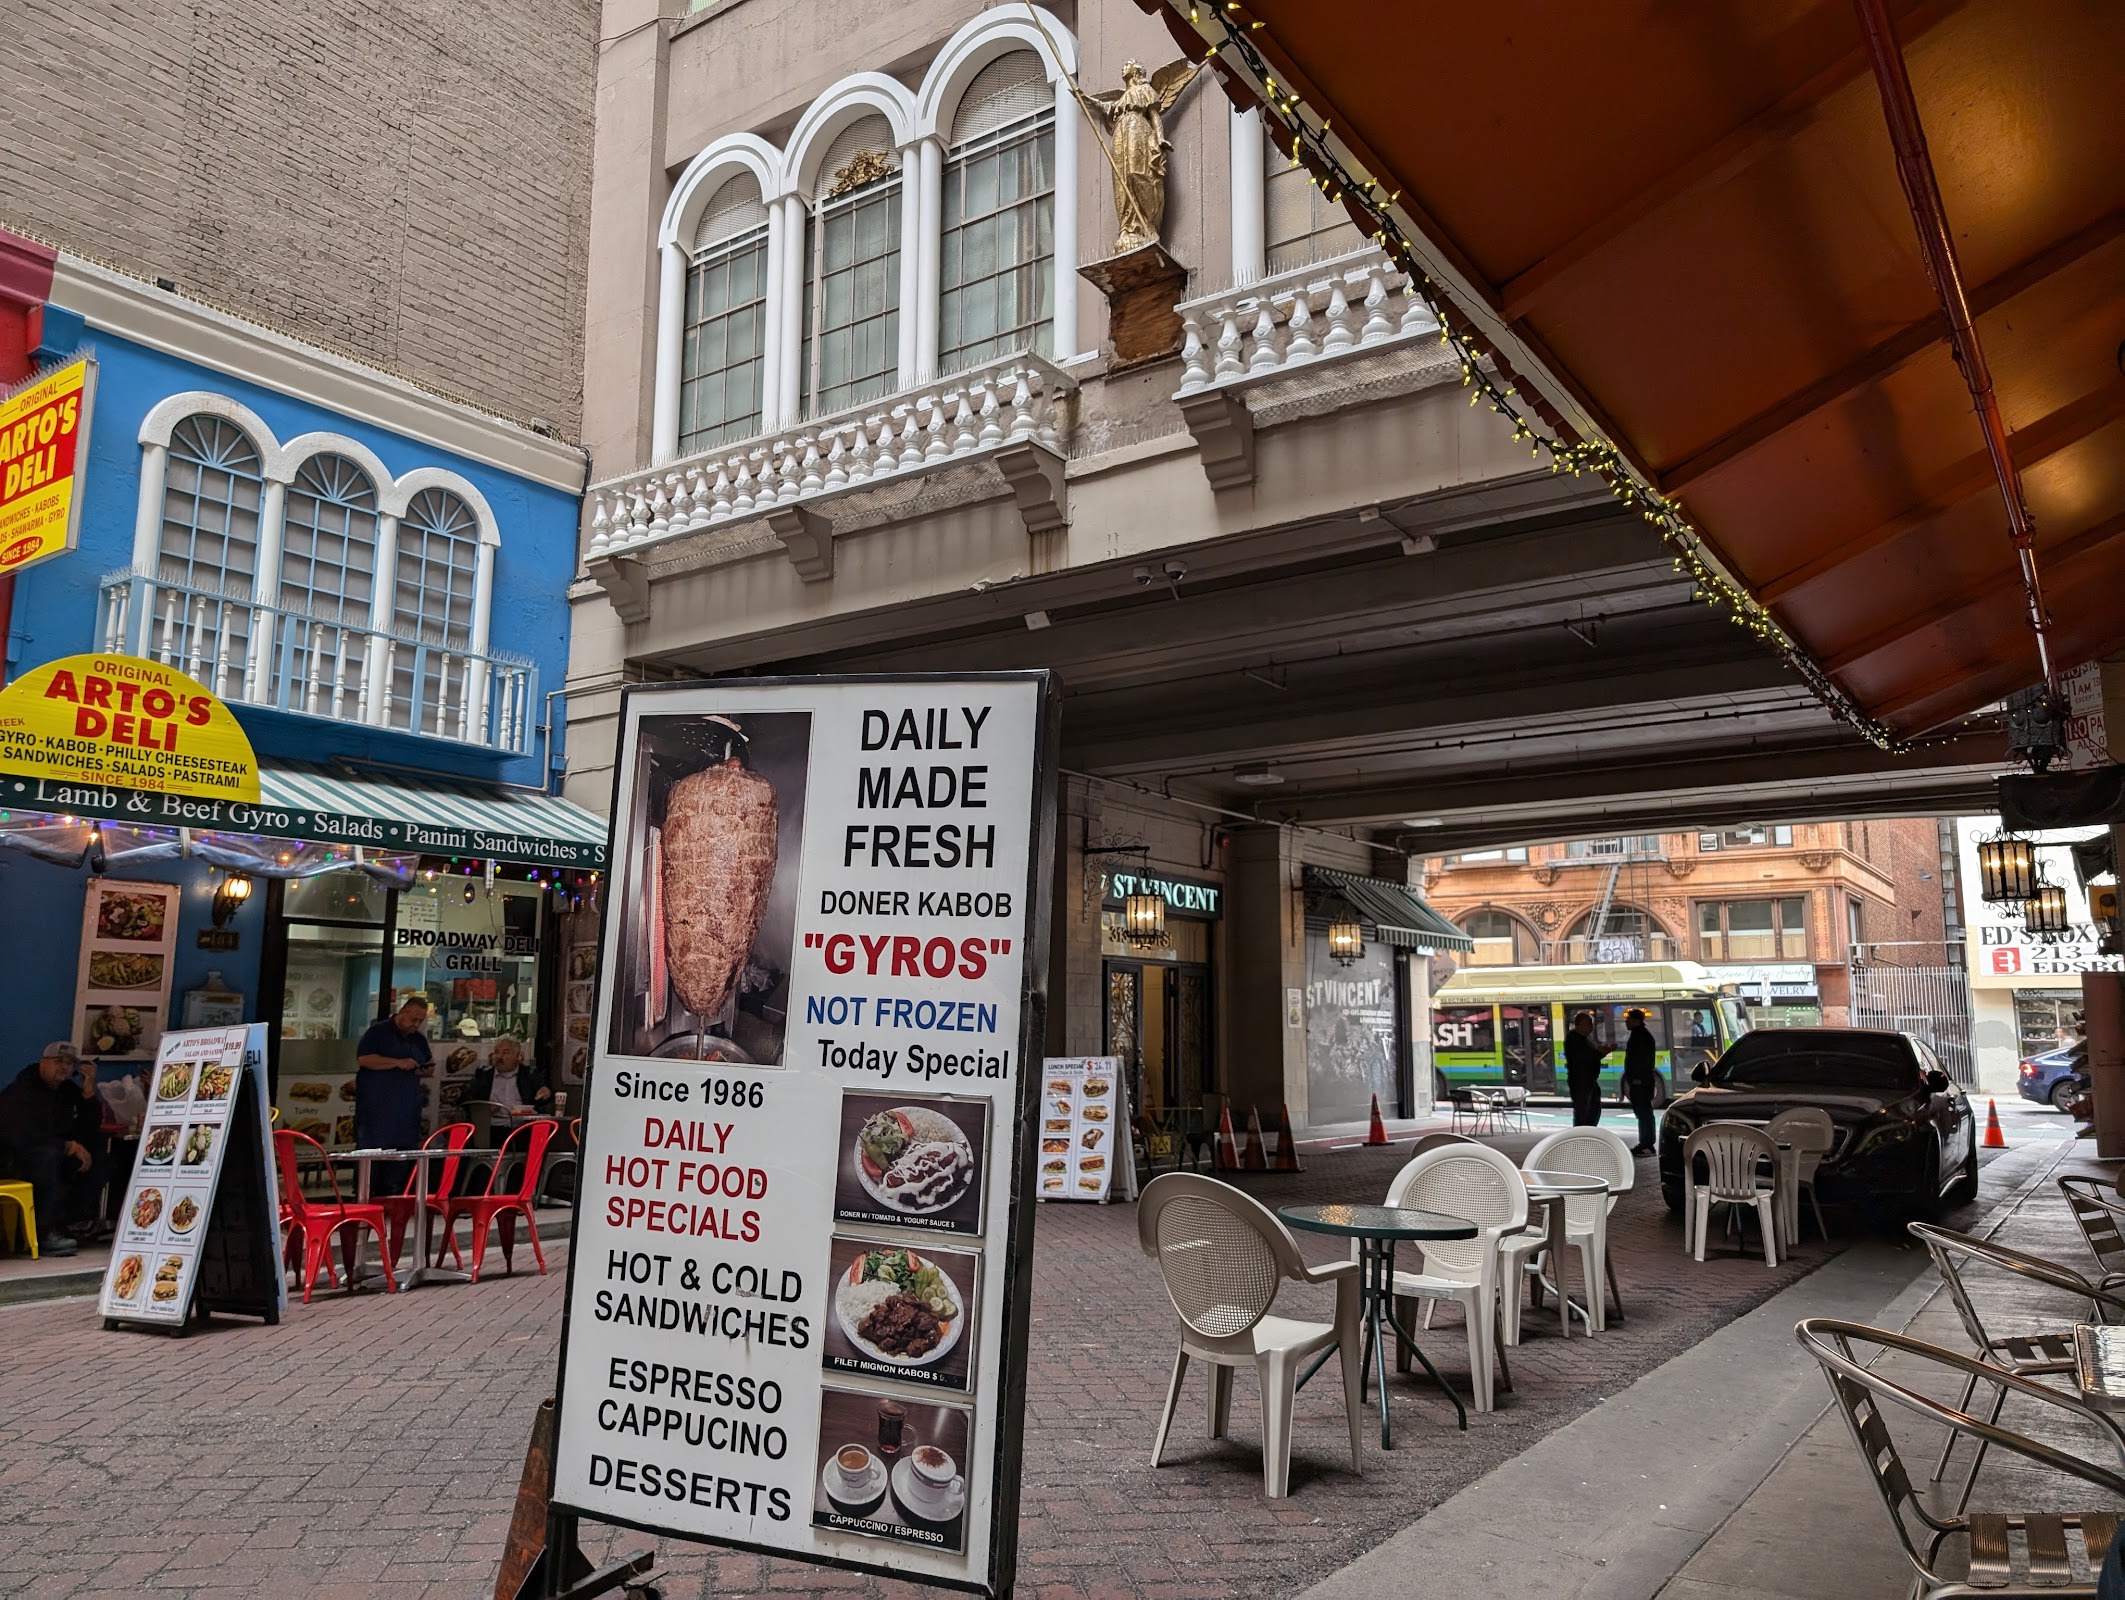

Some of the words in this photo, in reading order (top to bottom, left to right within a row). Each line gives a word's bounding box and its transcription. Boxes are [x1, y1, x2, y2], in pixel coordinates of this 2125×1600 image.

[20, 382, 58, 412] ORIGINAL
[0, 396, 78, 465] ARTO'S
[4, 444, 57, 500] DELI
[34, 494, 60, 514] KABOBS
[48, 507, 65, 524] GYRO
[11, 516, 44, 540] SHAWARMA
[1, 545, 21, 565] SINCE
[22, 537, 40, 557] 1984
[44, 669, 212, 726] ARTO'S
[75, 706, 179, 752] DELI
[861, 706, 992, 751] DAILY
[2067, 719, 2088, 740] NO
[0, 729, 36, 747] GYRO
[46, 736, 97, 755] KABOB
[106, 745, 152, 764] PHILLY
[156, 752, 248, 776] CHEESESTEAK
[4, 747, 103, 770] SANDWICHES
[112, 761, 165, 778] SALADS
[174, 770, 240, 788] PASTRAMI
[81, 770, 124, 787] SINCE
[130, 777, 165, 791] 1984
[857, 765, 989, 809] MADE
[35, 779, 118, 809] Lamb
[126, 791, 152, 813] &
[160, 794, 222, 823] Beef
[229, 802, 290, 830] Gyro
[313, 813, 384, 840] Salads
[404, 824, 467, 848] Panini
[473, 831, 578, 860] Sandwiches
[844, 824, 996, 868] FRESH
[820, 890, 914, 917] DONER
[918, 891, 1013, 918] KABOB
[1113, 873, 1137, 899] ST
[396, 928, 499, 950] BROADWAY
[504, 936, 541, 953] DELI
[1980, 924, 2035, 946] ED'S
[429, 953, 442, 969] &
[446, 954, 502, 973] GRILL
[804, 932, 1012, 980] "GYROS"
[1776, 964, 1812, 982] Jewelry
[1324, 978, 1381, 1008] VINCENT
[806, 995, 867, 1026] NOT
[875, 998, 998, 1033] FROZEN
[224, 1042, 242, 1051] $19.99
[817, 1038, 899, 1079] Today
[906, 1044, 1010, 1081] Special
[614, 1071, 690, 1103] Since
[699, 1077, 765, 1109] 1986
[644, 1118, 734, 1155] DAILY
[606, 1155, 668, 1191] HOT
[678, 1161, 768, 1200] FOOD
[606, 1196, 762, 1244] SPECIALS
[840, 1210, 861, 1219] DONER
[872, 1213, 896, 1222] TOMATO
[904, 1216, 928, 1226] YOGURT
[930, 1219, 950, 1228] SAUCE
[608, 1248, 672, 1288] HOT
[680, 1256, 701, 1292] &
[712, 1262, 803, 1304] COLD
[594, 1290, 810, 1350] SANDWICHES
[608, 1356, 783, 1414] ESPRESSO
[834, 1356, 858, 1368] FILET
[860, 1361, 896, 1374] MIGNON
[898, 1367, 930, 1379] KABOB
[932, 1372, 938, 1381] $
[598, 1398, 788, 1460] CAPPUCINO
[588, 1454, 792, 1522] DESSERTS
[829, 1514, 888, 1532] CAPPUCCINO
[894, 1526, 944, 1542] ESPRESSO
